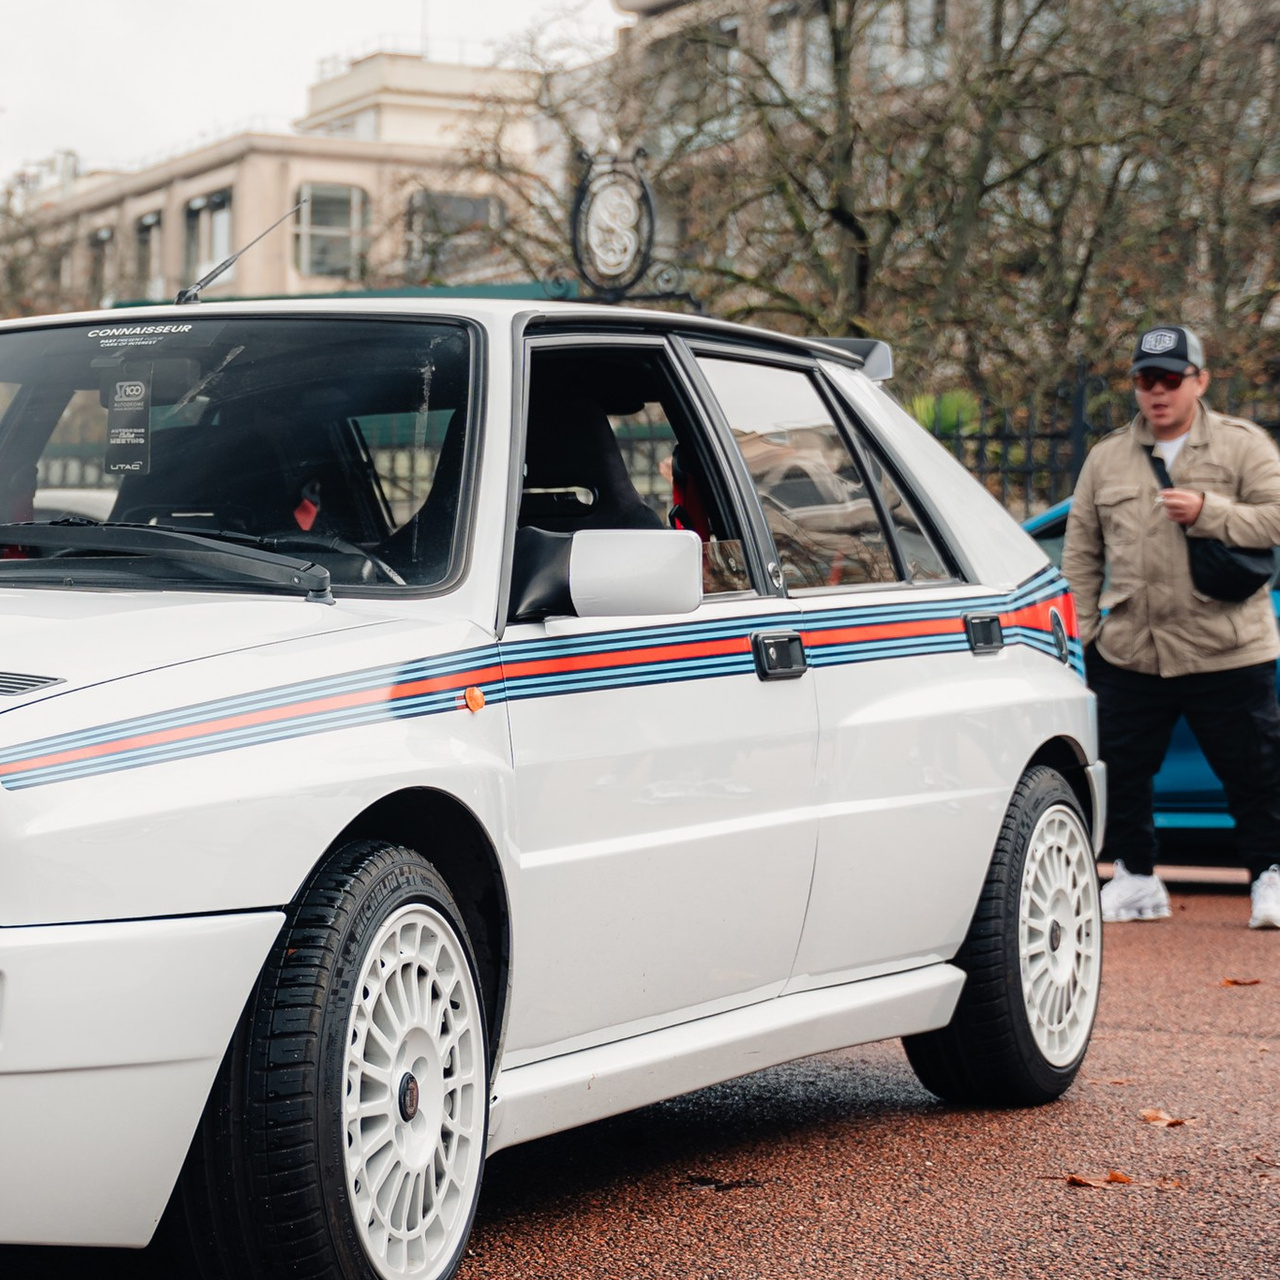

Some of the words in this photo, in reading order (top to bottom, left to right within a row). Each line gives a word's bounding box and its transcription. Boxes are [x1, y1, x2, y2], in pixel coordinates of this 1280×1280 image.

[87, 324, 193, 338] CONNAISSEUR
[125, 385, 142, 396] 100
[352, 871, 401, 943] MICHELIN
